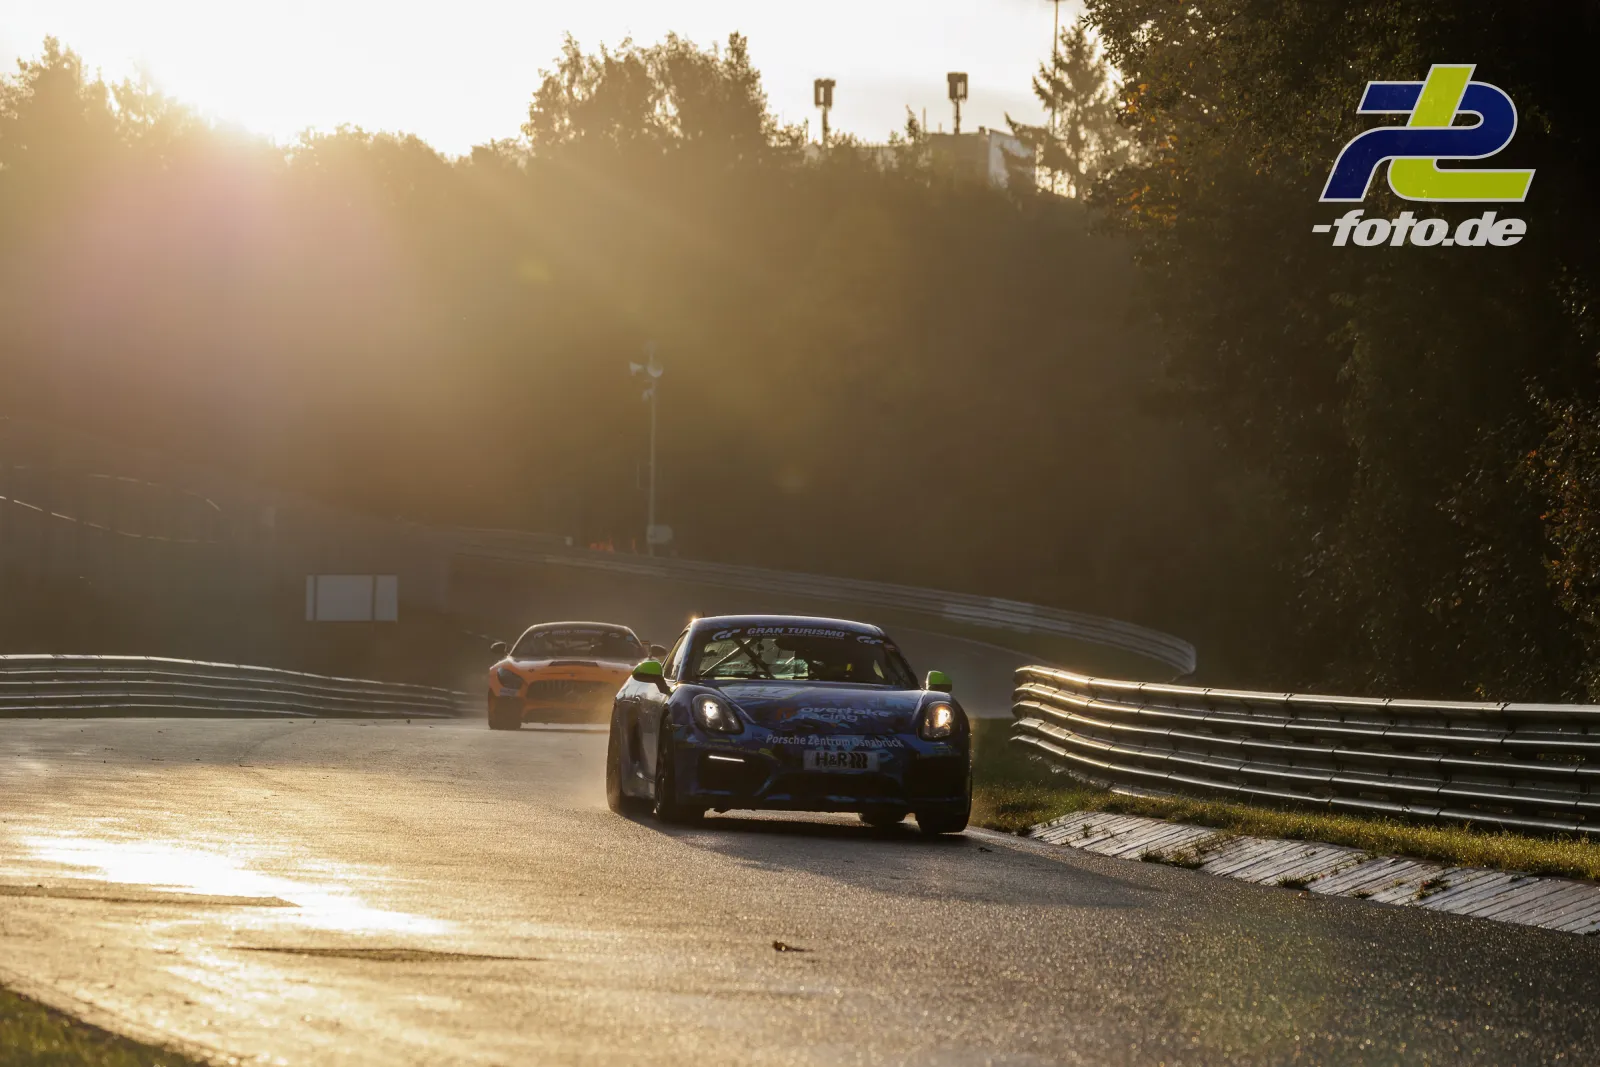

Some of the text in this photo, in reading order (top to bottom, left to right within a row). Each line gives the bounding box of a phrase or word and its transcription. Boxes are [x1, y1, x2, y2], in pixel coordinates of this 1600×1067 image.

[747, 627, 784, 635] GRAN
[788, 627, 845, 638] TURISMO
[766, 735, 904, 748] Porsche Zentrum Osnabrück
[815, 752, 847, 768] H&R
